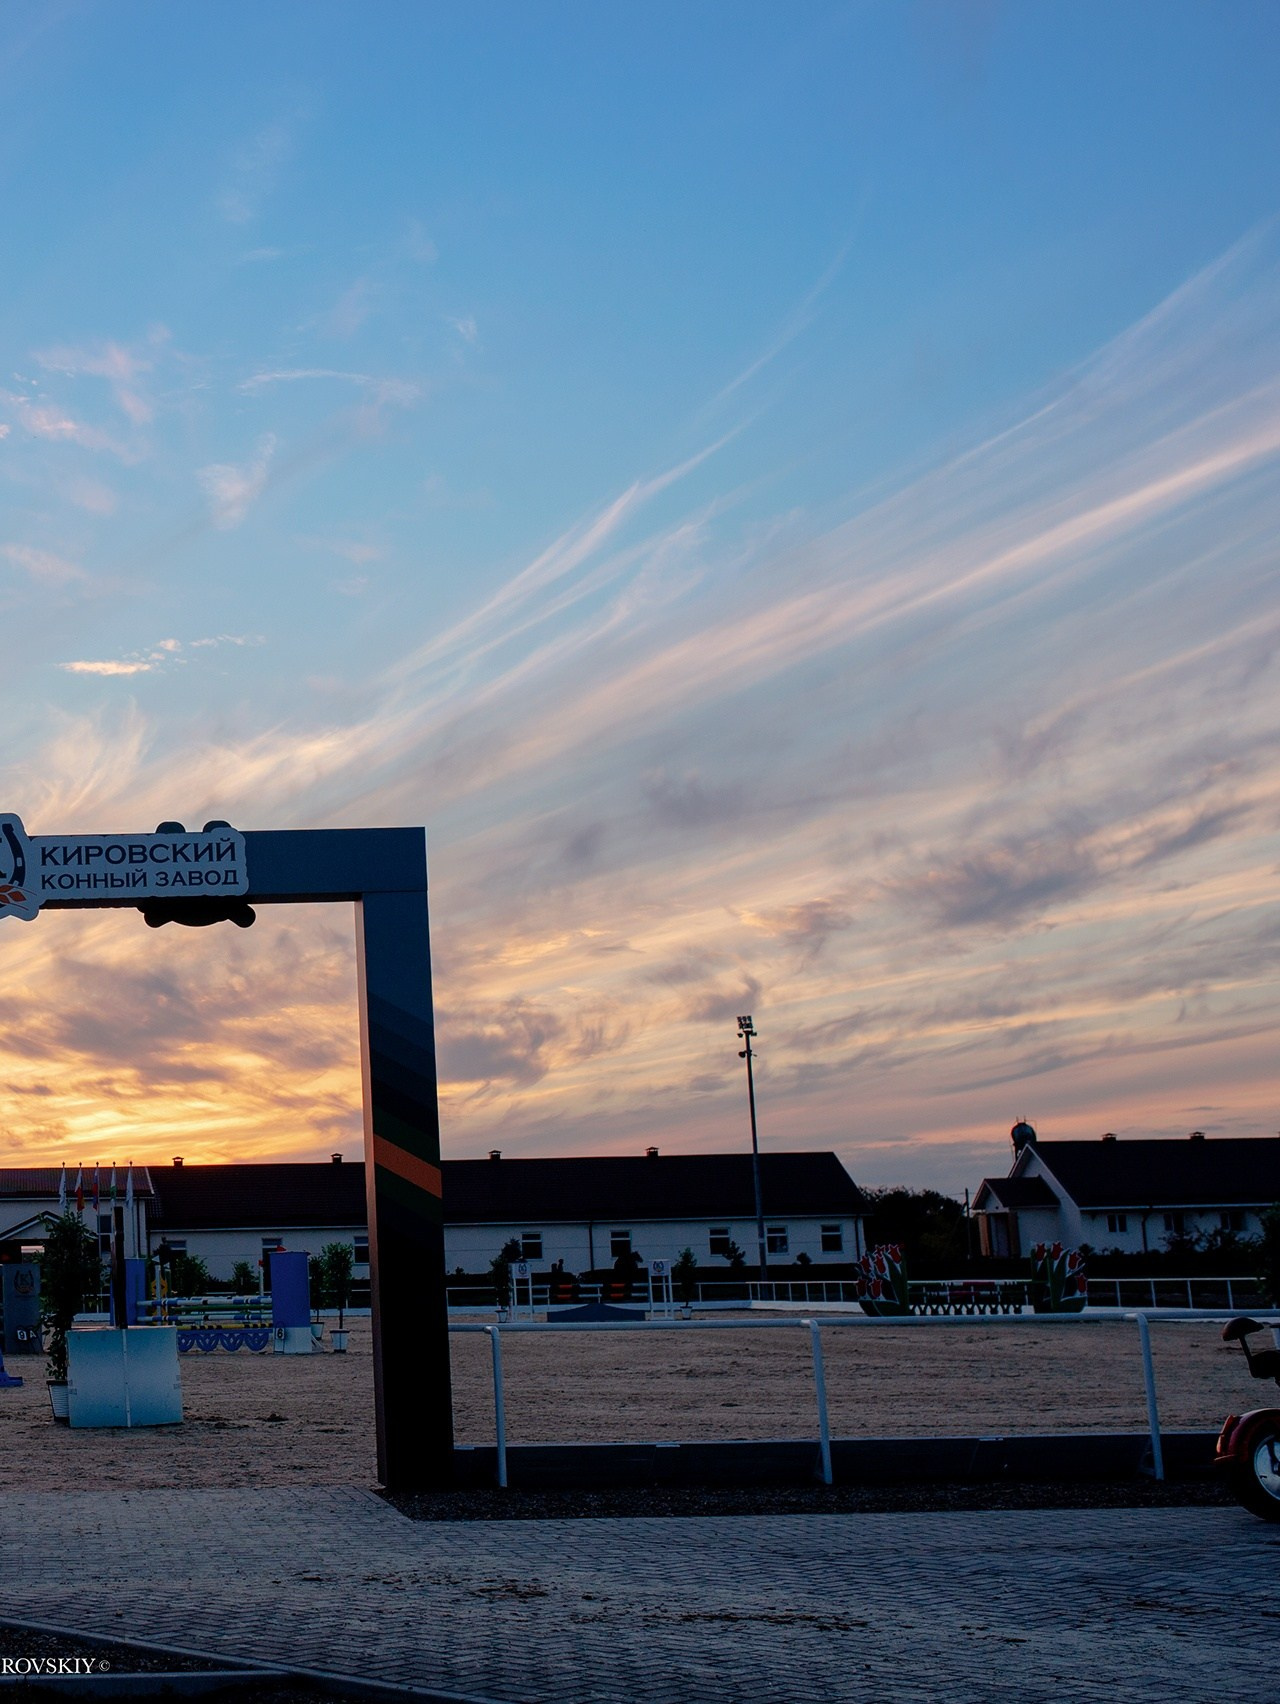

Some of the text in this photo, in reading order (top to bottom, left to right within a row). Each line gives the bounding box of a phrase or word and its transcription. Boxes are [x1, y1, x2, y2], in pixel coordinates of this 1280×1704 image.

[40, 838, 237, 867] КИРОВСКИЙ
[40, 868, 239, 890] КОННЫЙ ЗАВОД
[277, 1327, 283, 1338] 6
